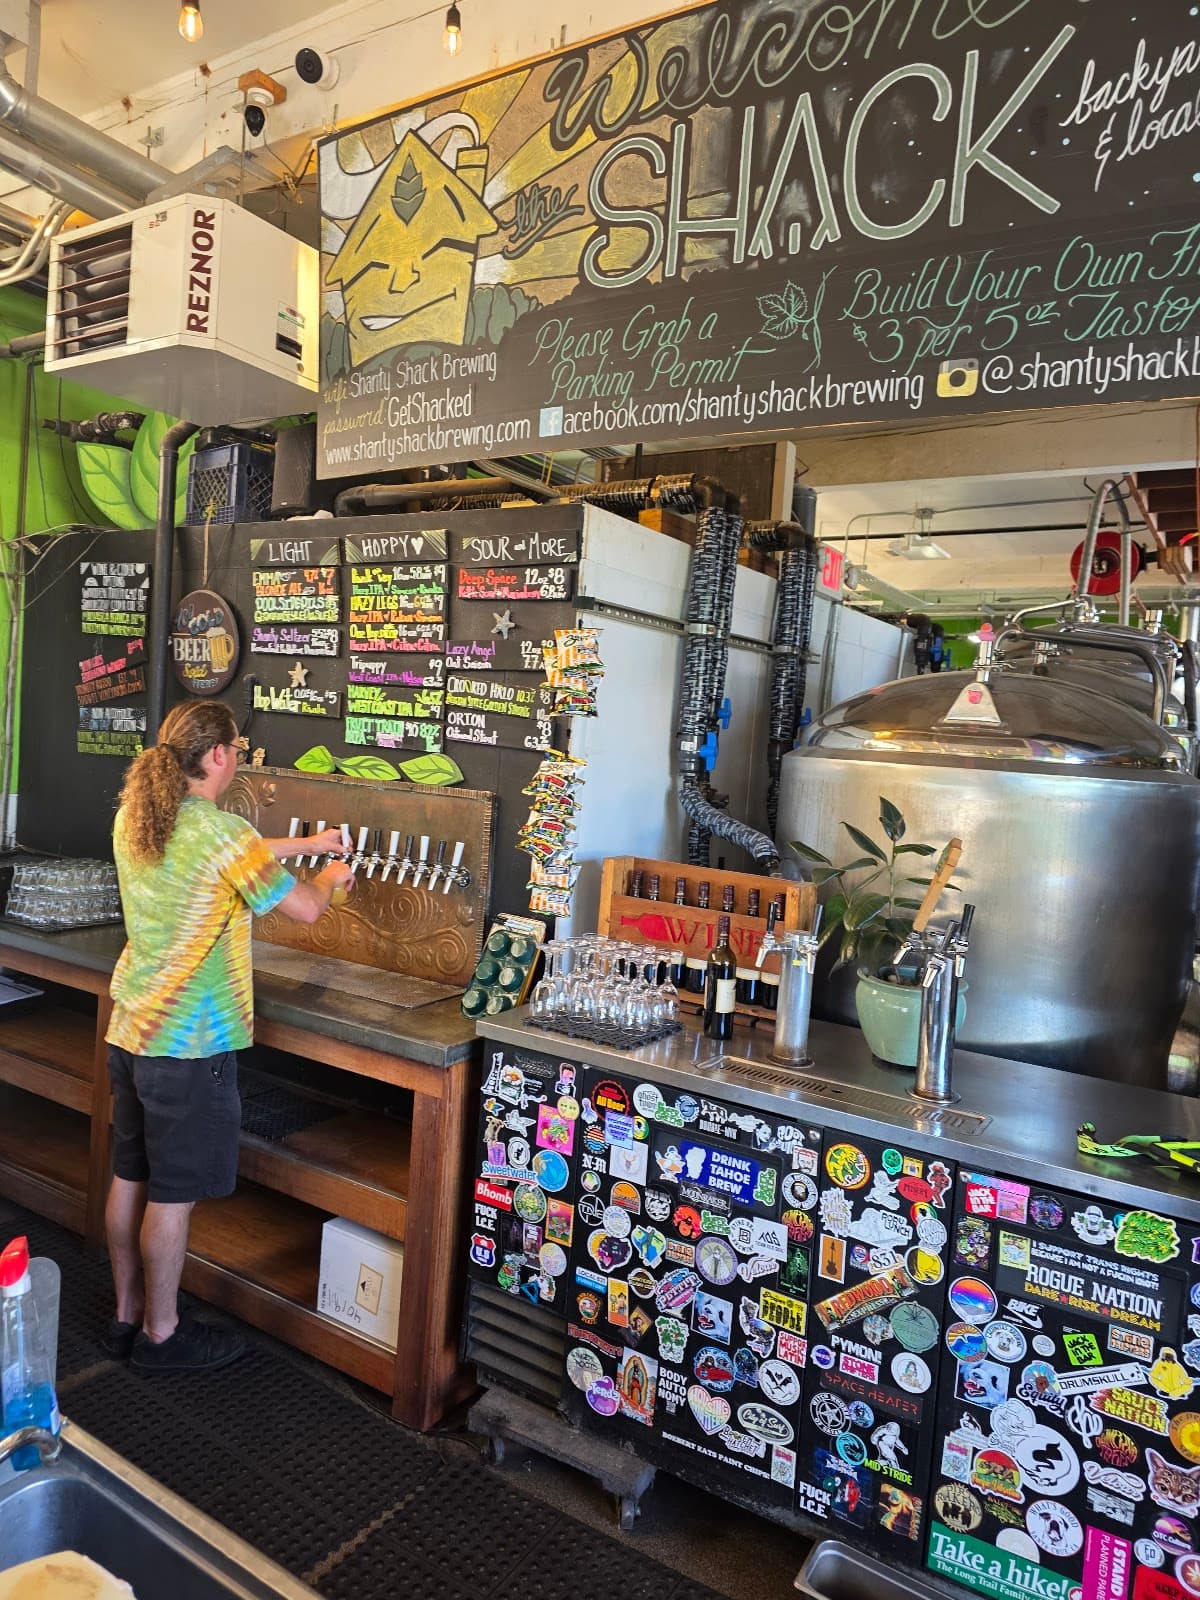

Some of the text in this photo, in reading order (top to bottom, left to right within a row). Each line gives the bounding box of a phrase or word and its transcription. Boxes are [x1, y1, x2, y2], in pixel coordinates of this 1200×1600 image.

[579, 24, 1076, 288] SHACK
[501, 184, 584, 260] the
[186, 209, 216, 334] REZNOR
[838, 257, 936, 321] Build
[1053, 236, 1144, 292] Own
[528, 297, 718, 367] Please Grab a
[906, 322, 972, 376] per
[350, 367, 391, 400] Shanty
[396, 358, 438, 389] Shack
[442, 351, 497, 382] Brewing
[544, 337, 777, 410] Parking Permit
[388, 384, 473, 429] GetShacked
[540, 371, 924, 438] facebook.com/shantyshackbrewing
[326, 417, 531, 465] www.shantyshackbrewing.com
[268, 541, 313, 563] LIGHT
[361, 534, 410, 558] HOPPY
[471, 536, 515, 562] SOUR
[173, 637, 212, 662] BEER
[349, 655, 387, 675] Trippy
[481, 1161, 538, 1181] Sweetwater
[709, 1163, 752, 1185] TAHOE
[711, 1151, 752, 1172] DRINK
[476, 1182, 513, 1206] Bhomb
[707, 1175, 743, 1196] BREW
[474, 1202, 498, 1220] FUCK
[1038, 1241, 1083, 1259] SUPPORT
[1085, 1254, 1119, 1271] TRANS
[1024, 1281, 1162, 1332] DARE RISK DREAM
[1025, 1263, 1163, 1320] ROGUE NATION
[1007, 1298, 1041, 1317] BIKE
[1067, 1335, 1089, 1350] JACK
[658, 1366, 688, 1386] BODY
[658, 1377, 687, 1397] AUTO
[1059, 1371, 1131, 1391] DRUMSKULL
[657, 1387, 687, 1407] NOMY
[823, 1371, 919, 1416] SPACE HEATER
[1018, 1382, 1066, 1419] Equity
[1103, 1397, 1167, 1434] NATION
[718, 1454, 744, 1469] PAINT
[863, 1457, 914, 1486] MID STRIDE
[799, 1480, 832, 1507] FUCK
[932, 1531, 1069, 1600] Take a hike!
[1097, 1534, 1111, 1576] PLANNED
[1110, 1539, 1127, 1597] I STAND
[936, 1559, 953, 1575] The
[955, 1567, 977, 1584] Long
[978, 1574, 999, 1593] Trail
